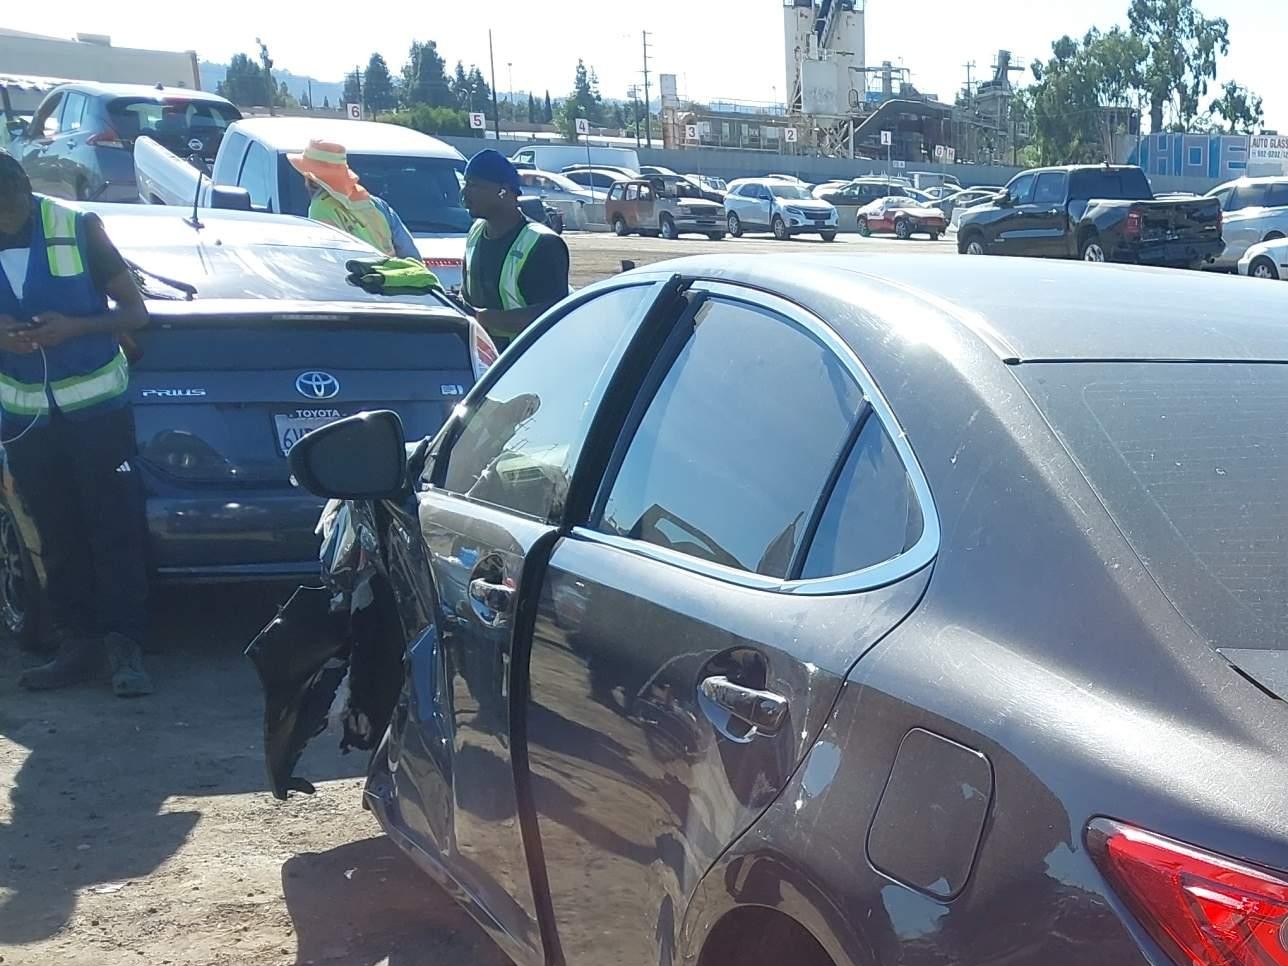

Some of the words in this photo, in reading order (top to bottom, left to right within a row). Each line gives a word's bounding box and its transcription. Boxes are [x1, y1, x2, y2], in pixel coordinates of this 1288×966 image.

[351, 105, 360, 118] 6
[473, 114, 482, 127] 5
[578, 119, 586, 132] 4
[688, 126, 696, 138] 3
[787, 130, 795, 140] 2
[883, 132, 889, 144] 1
[1252, 138, 1268, 148] AUTO
[143, 388, 206, 397] PRIUS
[296, 409, 341, 418] TOYOTA
